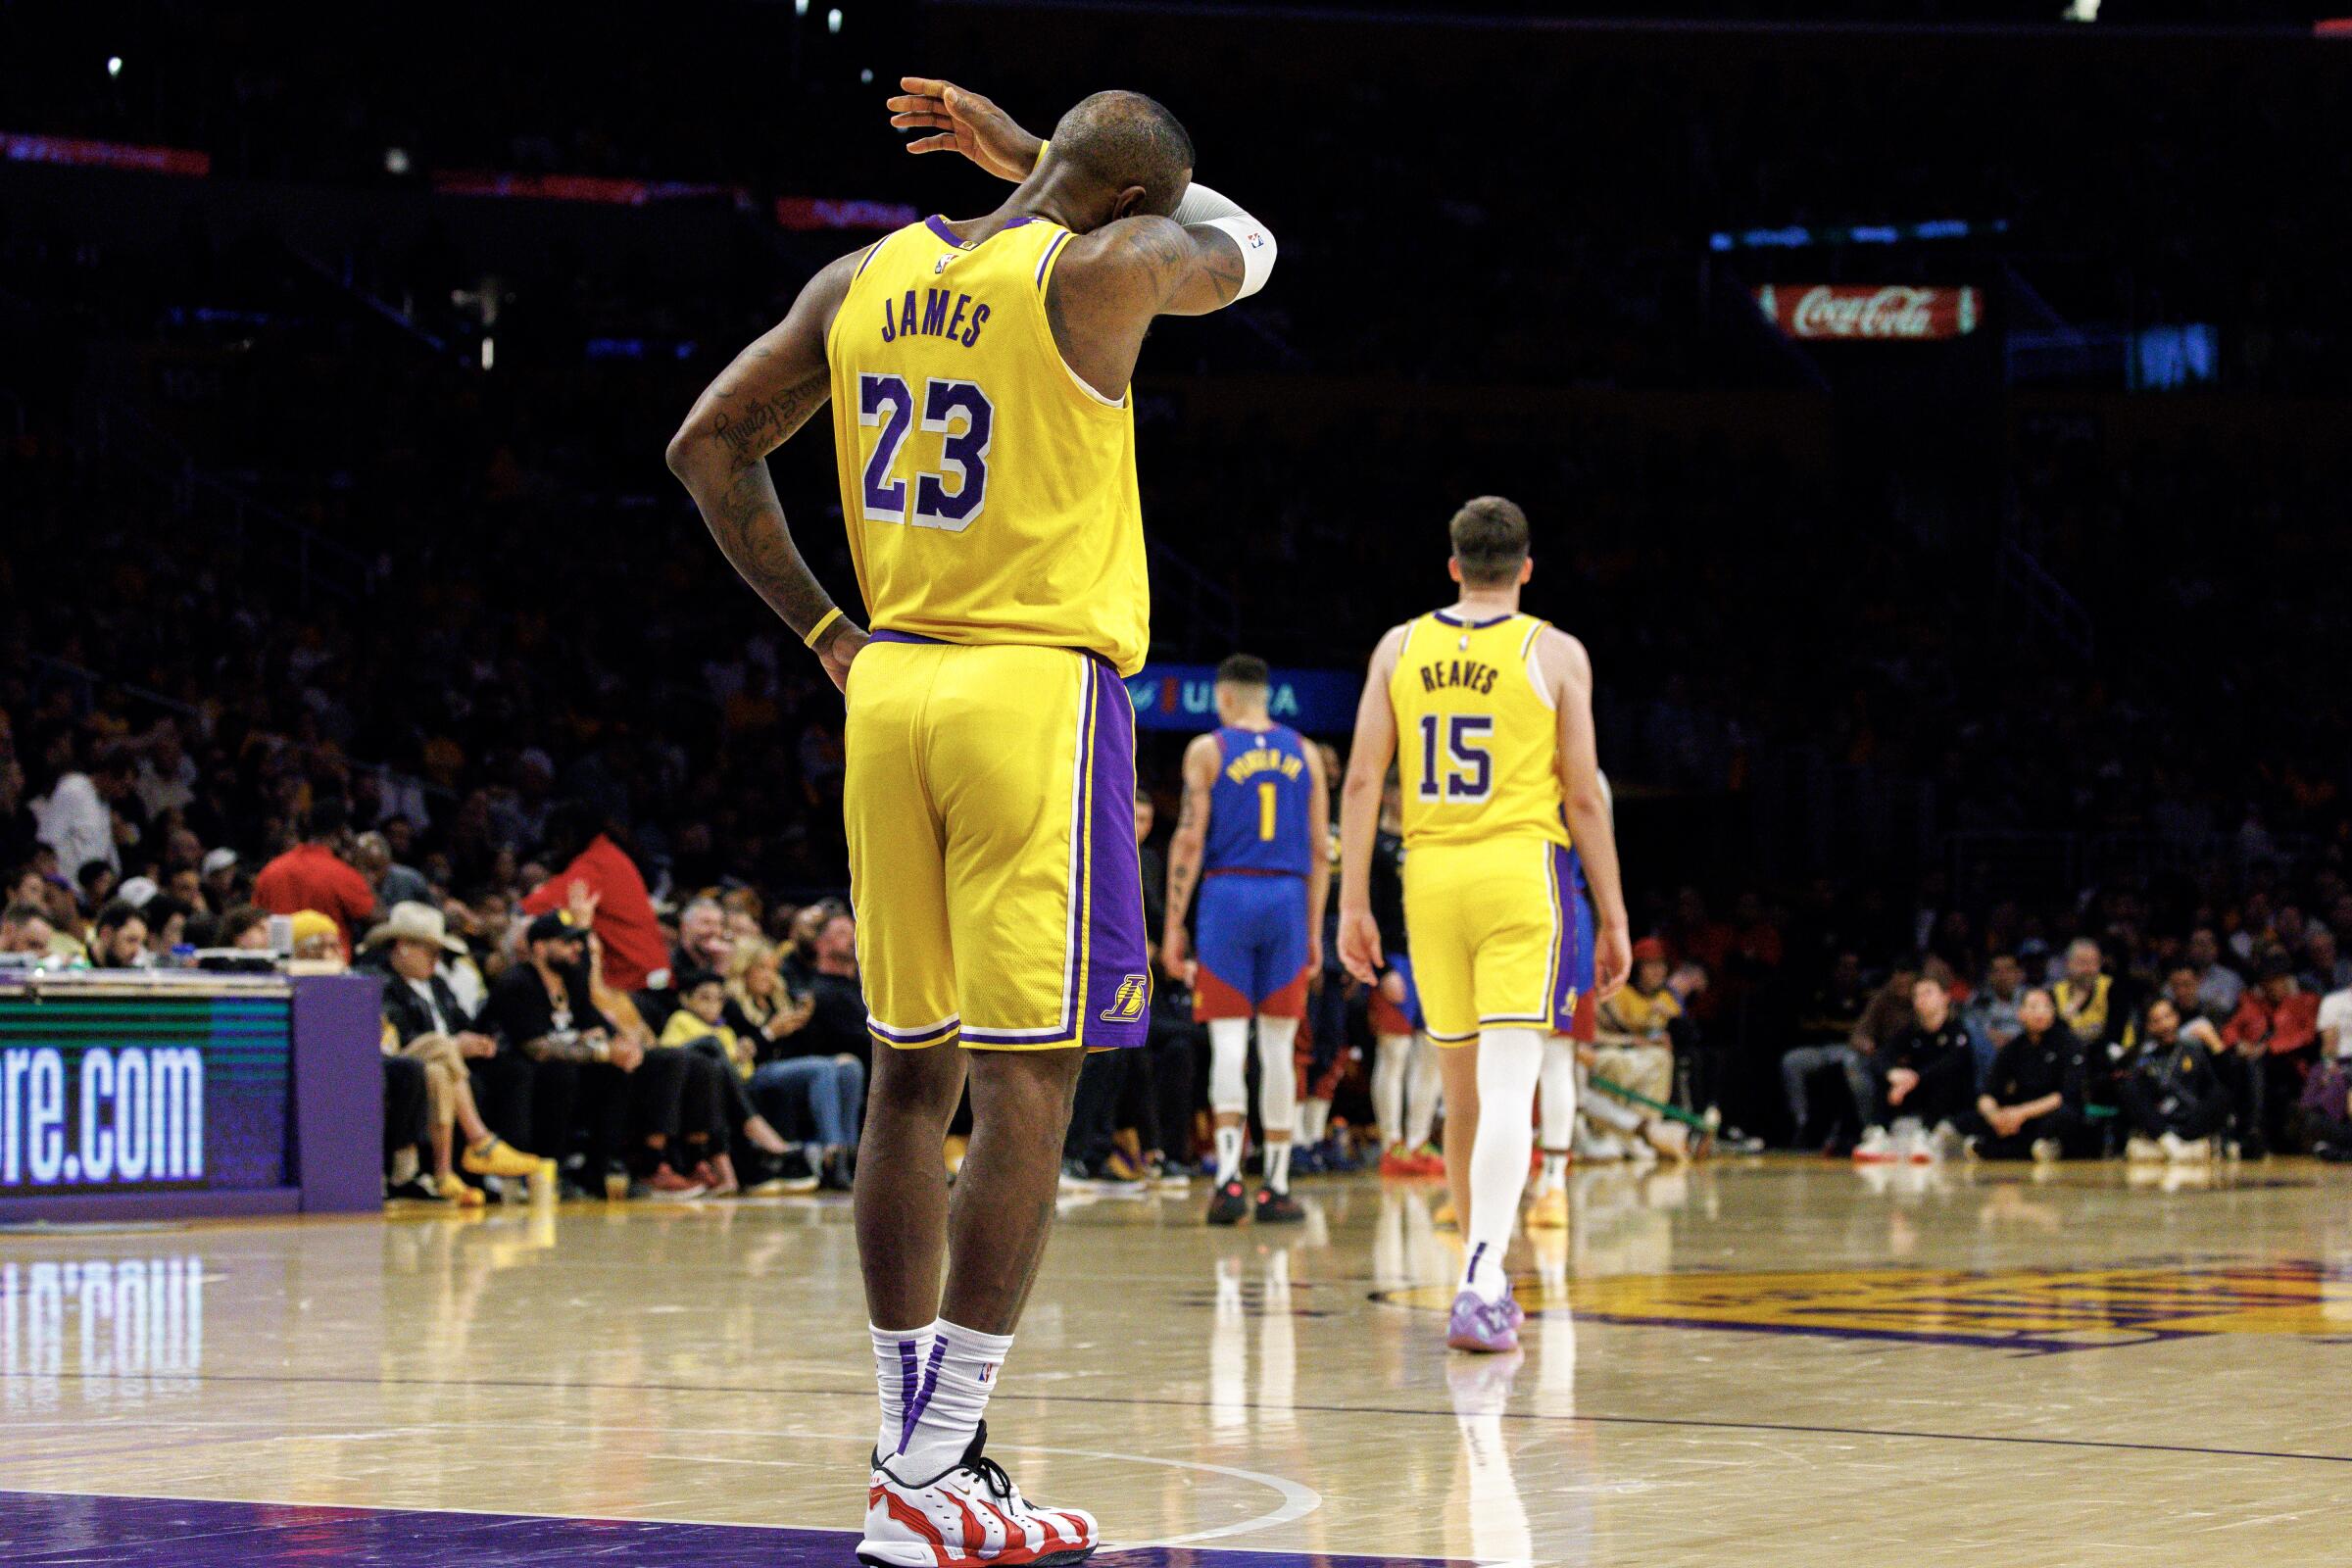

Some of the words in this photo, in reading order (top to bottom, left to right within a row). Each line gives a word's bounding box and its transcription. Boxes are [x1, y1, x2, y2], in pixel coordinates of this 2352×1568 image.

[882, 288, 991, 348] JAMES
[858, 372, 995, 532] 23
[1420, 661, 1498, 695] REAVES
[1419, 713, 1494, 804] 15
[1258, 782, 1276, 841] 1
[0, 1048, 204, 1182] re.com
